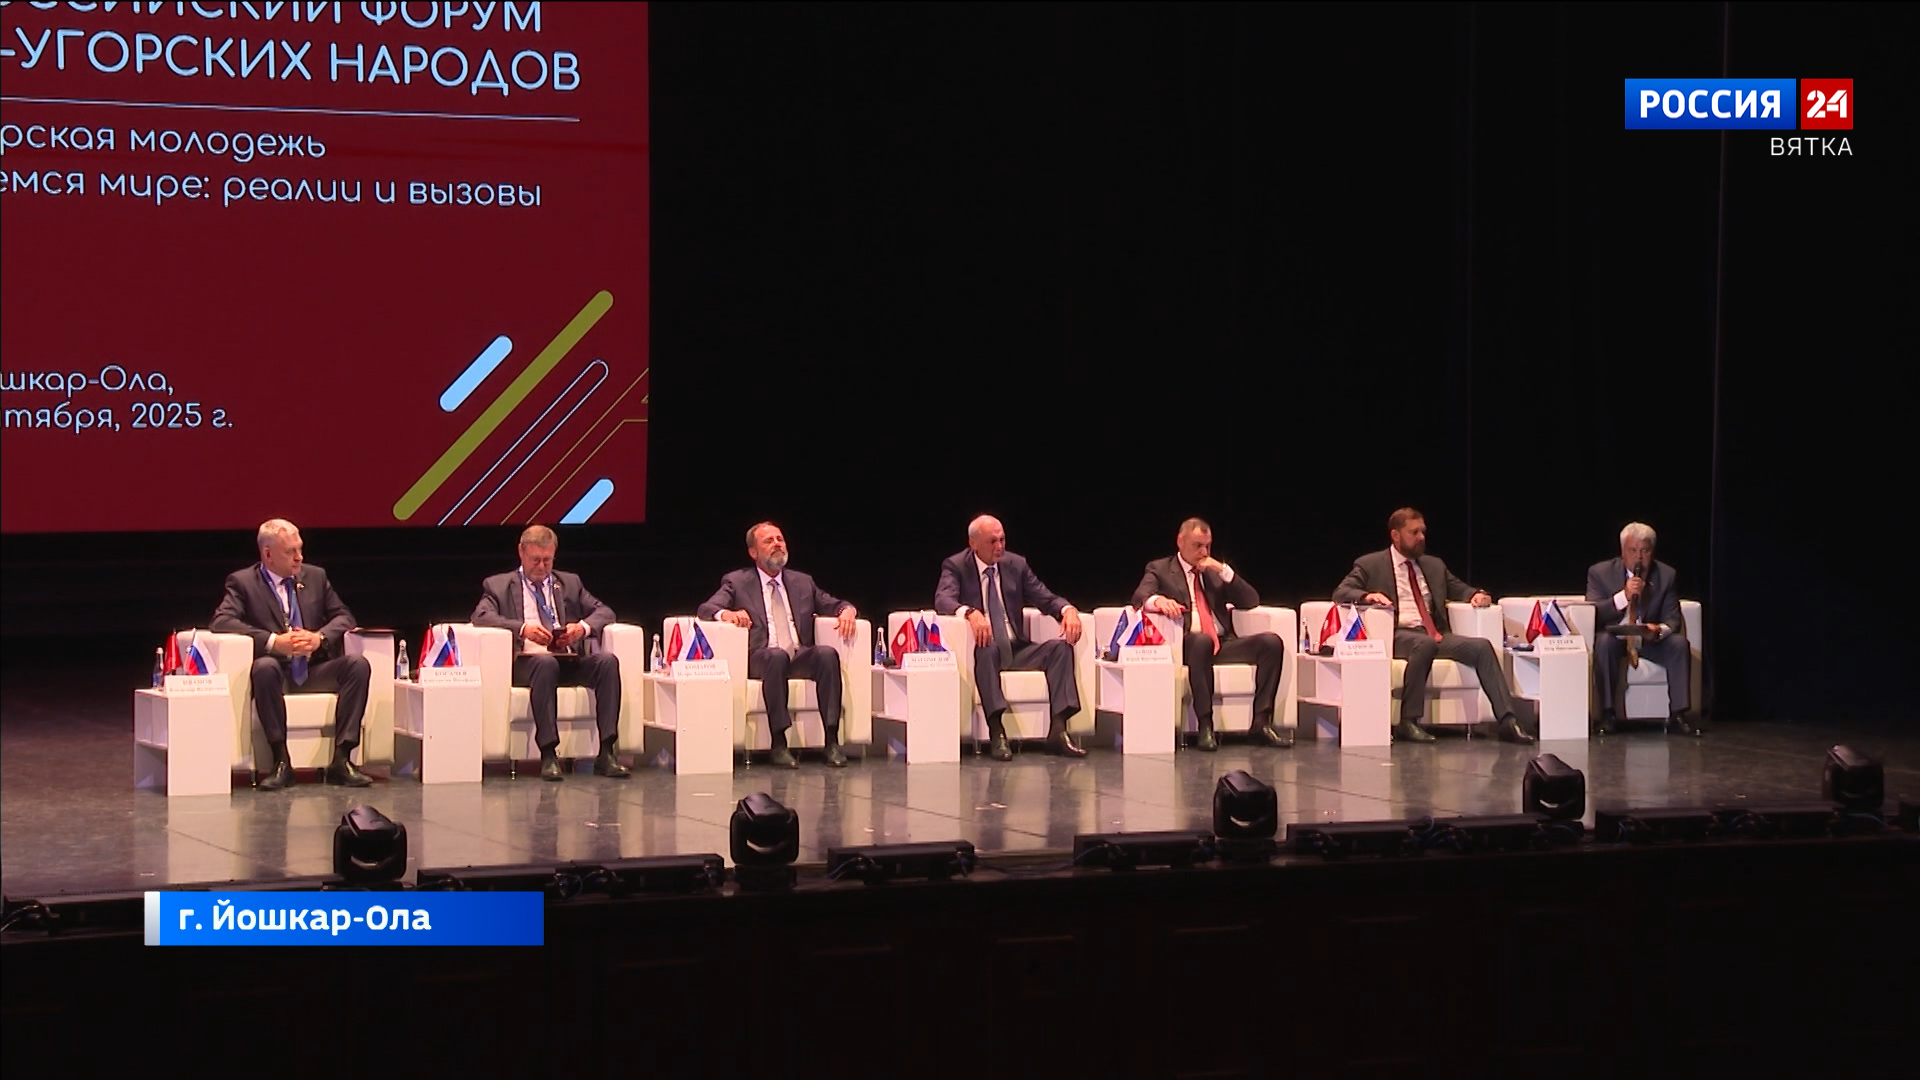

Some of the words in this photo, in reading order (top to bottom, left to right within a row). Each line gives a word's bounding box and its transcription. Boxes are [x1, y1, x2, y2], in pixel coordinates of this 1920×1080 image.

[361, 1, 541, 32] ФОРУМ
[330, 42, 581, 97] НАРОДОВ
[0, 124, 115, 155] рская
[130, 127, 326, 163] молодежь
[100, 173, 209, 206] мире:
[223, 176, 361, 208] реалии
[375, 181, 396, 203] и
[409, 181, 541, 207] вызовы
[0, 364, 174, 398] шкар-Ола,
[4, 401, 120, 434] тября,
[131, 402, 202, 428] 2025
[212, 408, 233, 428] г.
